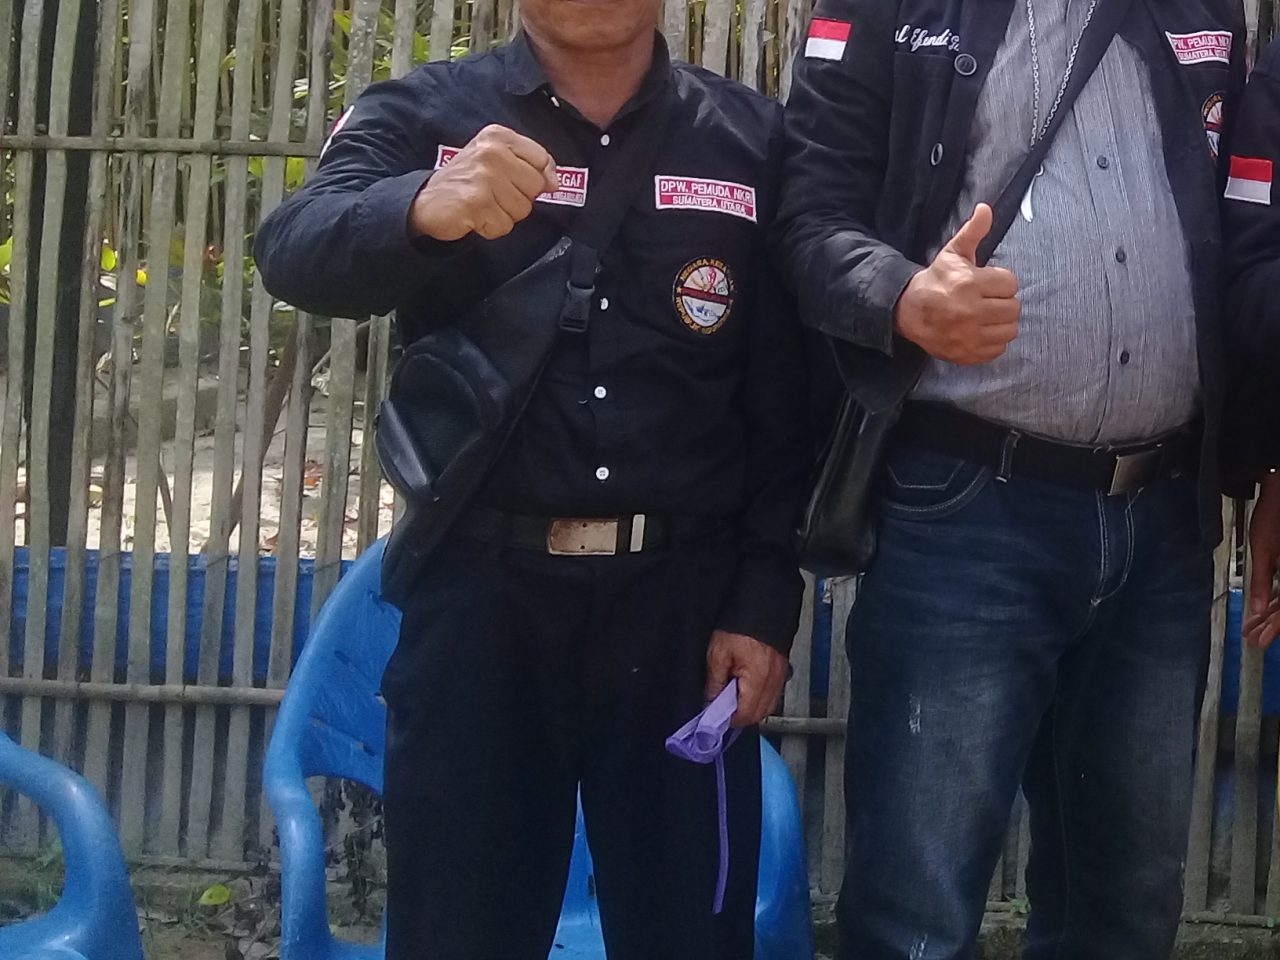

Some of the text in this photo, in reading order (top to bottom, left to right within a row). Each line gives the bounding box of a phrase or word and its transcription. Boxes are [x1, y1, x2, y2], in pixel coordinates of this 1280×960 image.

[910, 28, 952, 52] Efendi
[1188, 36, 1218, 49] PEMUDA
[661, 181, 753, 203] DPW. PEMUDA NKRI
[672, 196, 746, 215] SUMATERA UTARA
